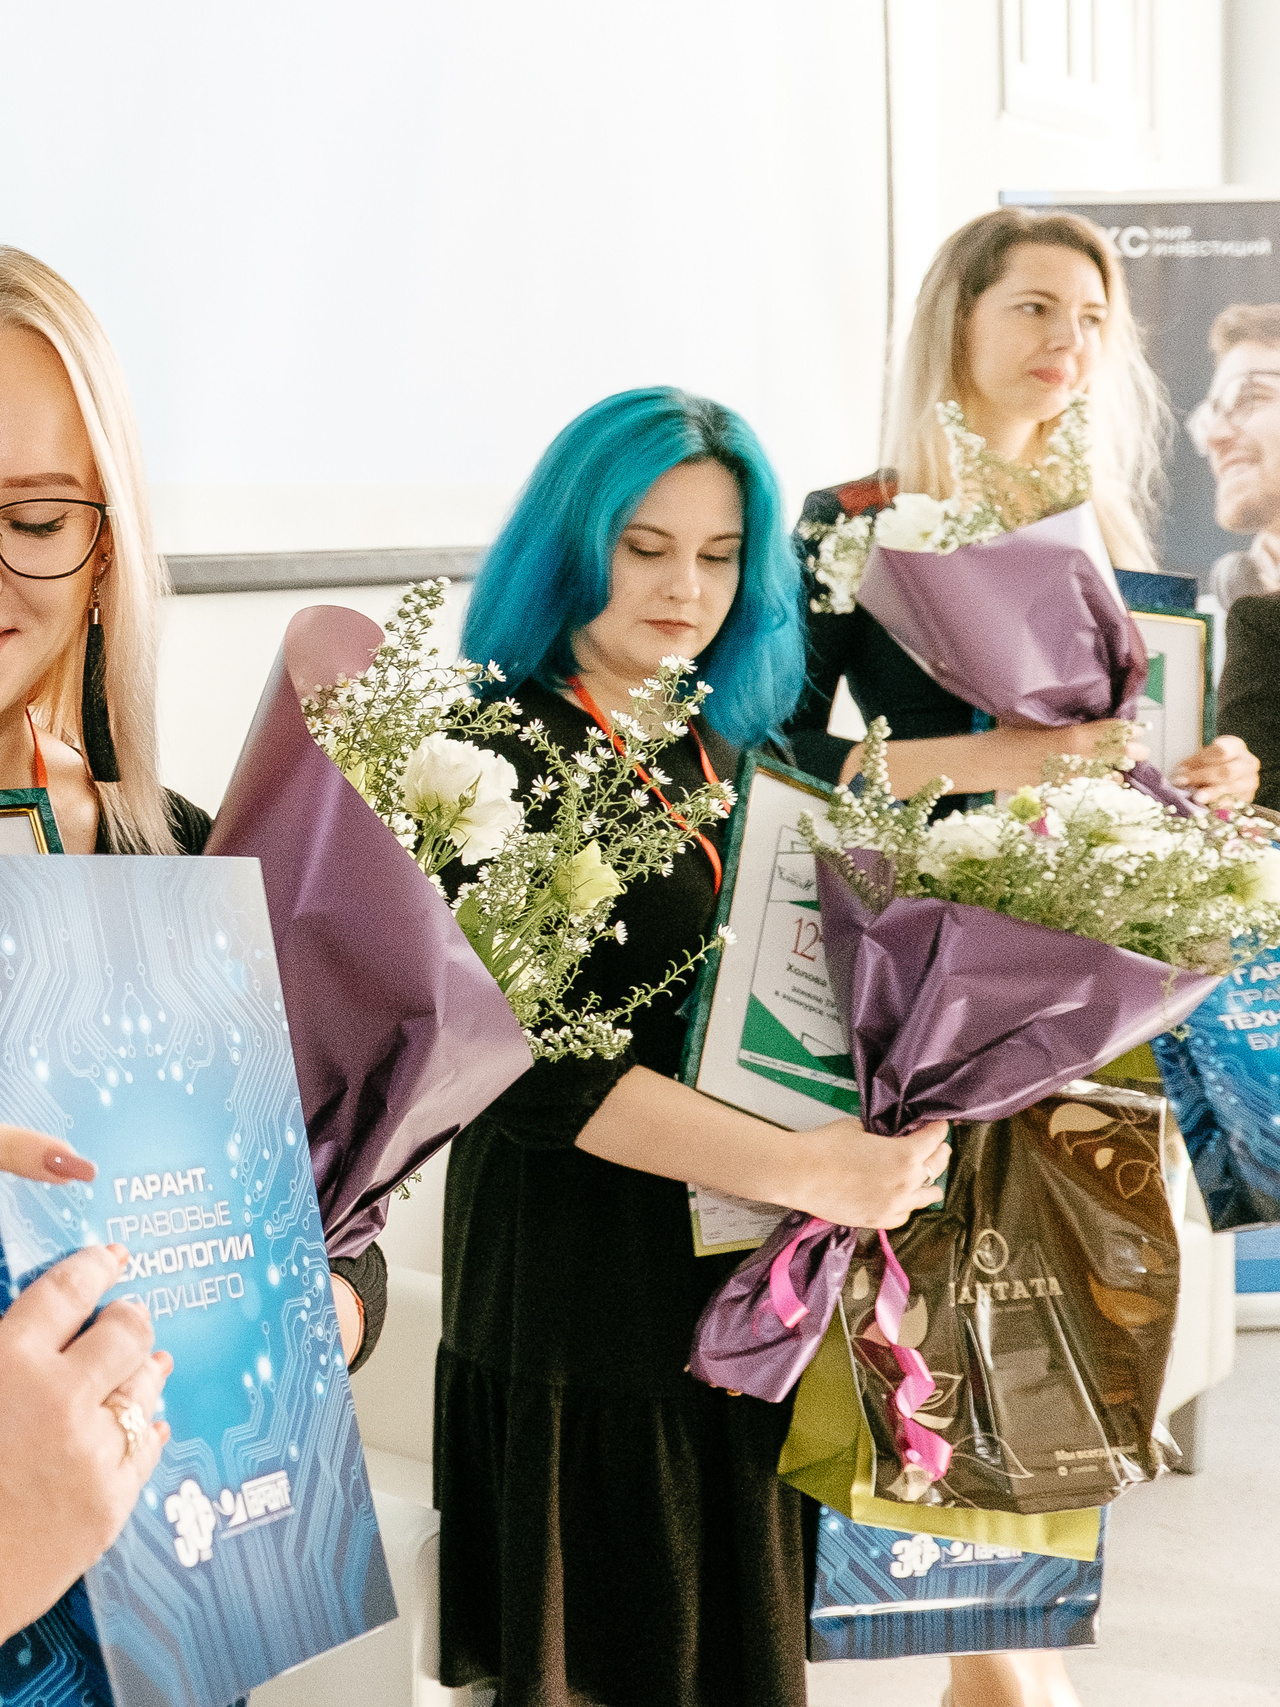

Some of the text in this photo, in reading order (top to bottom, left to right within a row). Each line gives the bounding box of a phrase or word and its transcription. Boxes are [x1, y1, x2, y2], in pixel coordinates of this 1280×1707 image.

[1219, 1010, 1280, 1031] ТЕХ
[114, 1167, 213, 1204] ГАРАНТ.
[106, 1201, 232, 1243] ПРАВОВЫЕ
[118, 1233, 254, 1283] ХНОЛОГИИ
